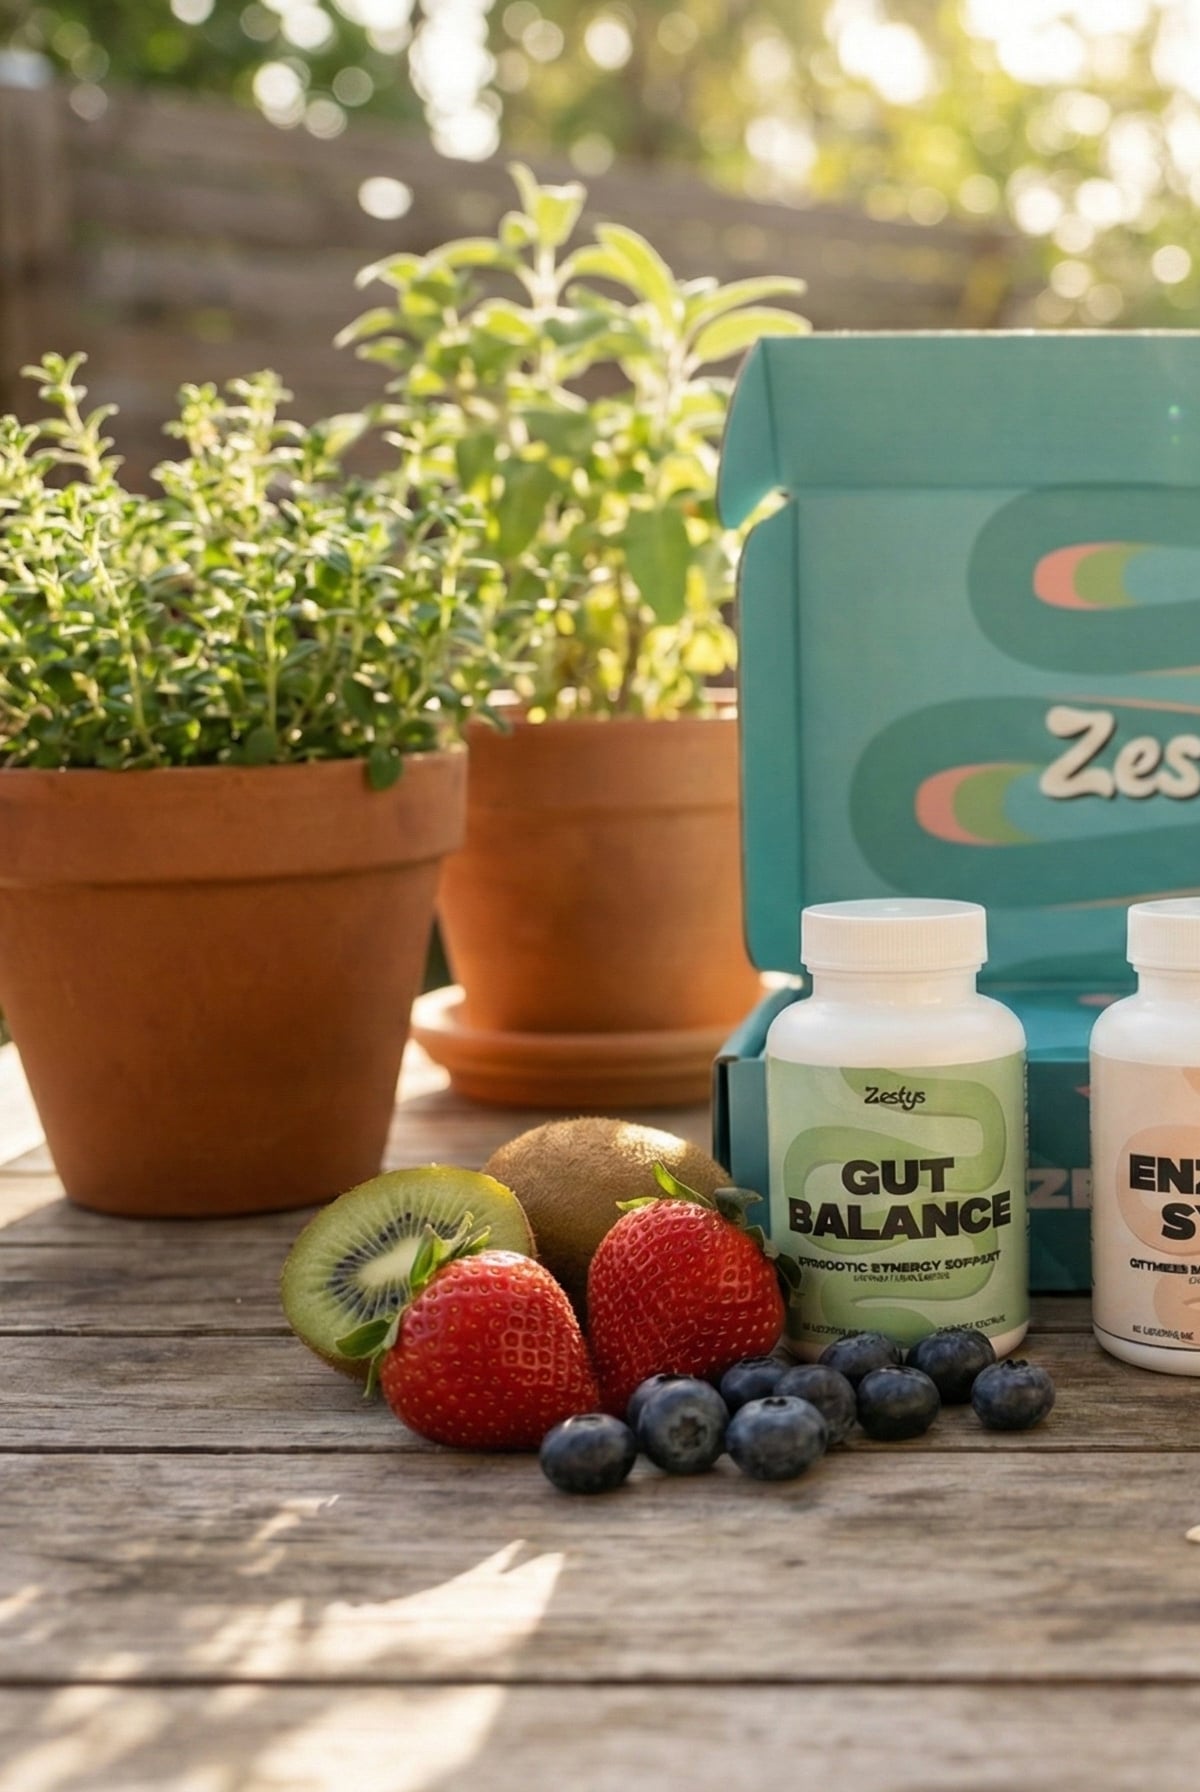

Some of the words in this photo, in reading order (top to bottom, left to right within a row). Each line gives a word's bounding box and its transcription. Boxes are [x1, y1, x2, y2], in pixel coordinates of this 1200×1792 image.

[864, 1086, 926, 1111] Zestys
[841, 1157, 955, 1196] GUT
[788, 1190, 1011, 1241] BALANCE
